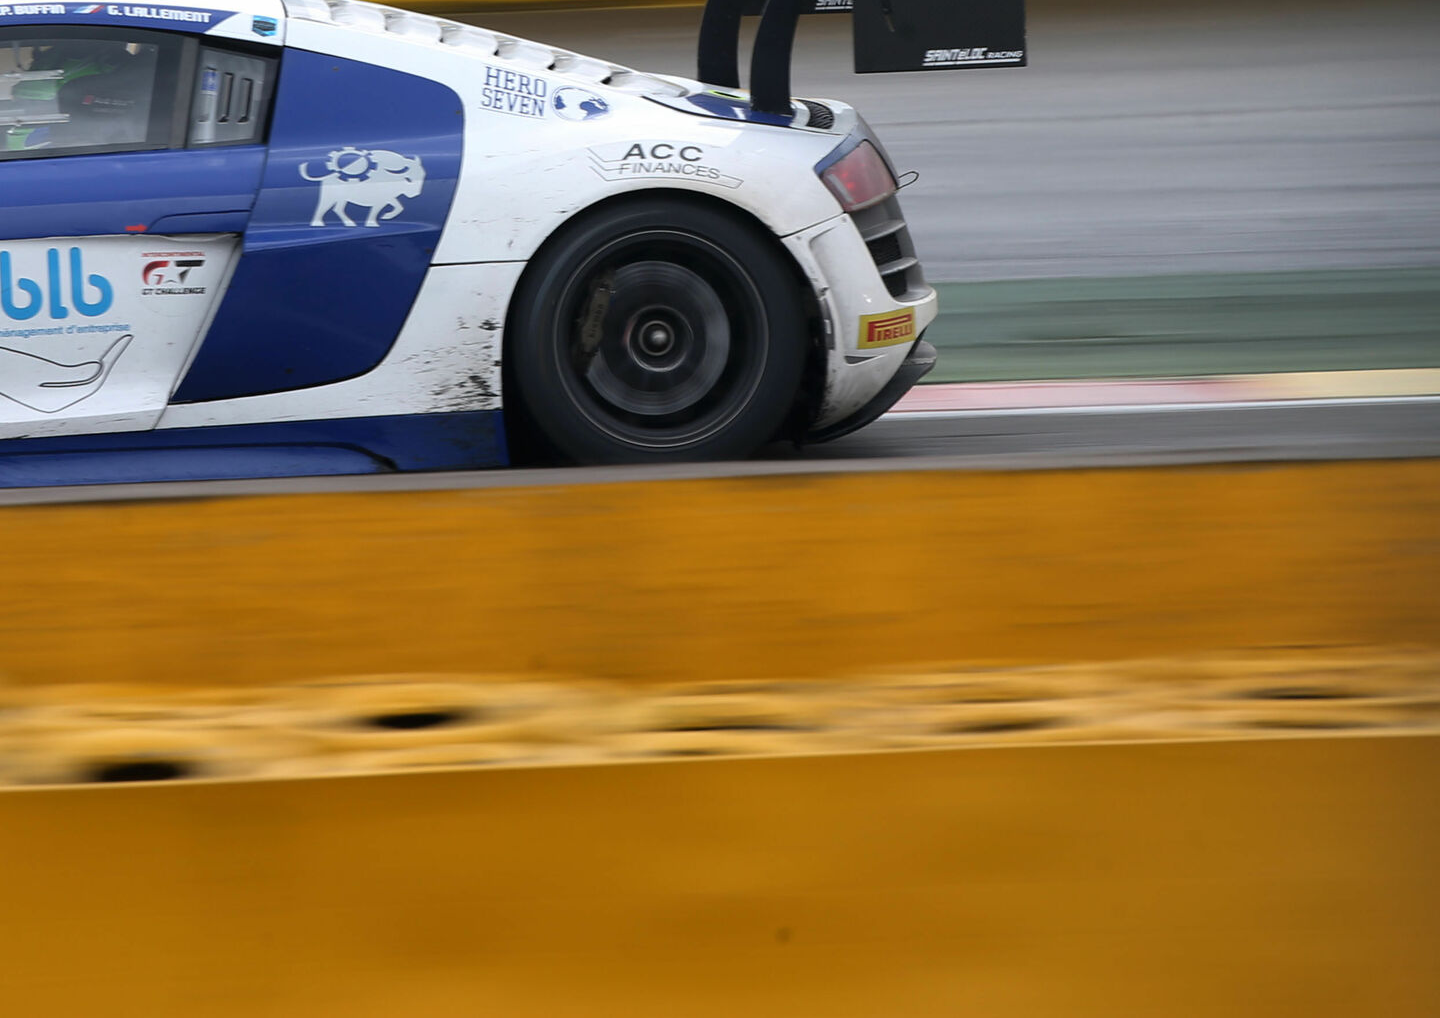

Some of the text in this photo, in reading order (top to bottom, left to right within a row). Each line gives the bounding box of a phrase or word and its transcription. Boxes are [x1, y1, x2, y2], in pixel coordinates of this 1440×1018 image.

[123, 6, 212, 23] LALLEMENT
[986, 50, 1023, 59] RACING
[483, 66, 548, 99] HERO
[481, 87, 545, 117] SEVEN
[622, 143, 704, 162] ACC
[619, 162, 721, 179] FINANCES
[0, 247, 114, 320] blb
[867, 313, 912, 342] PIRELLI
